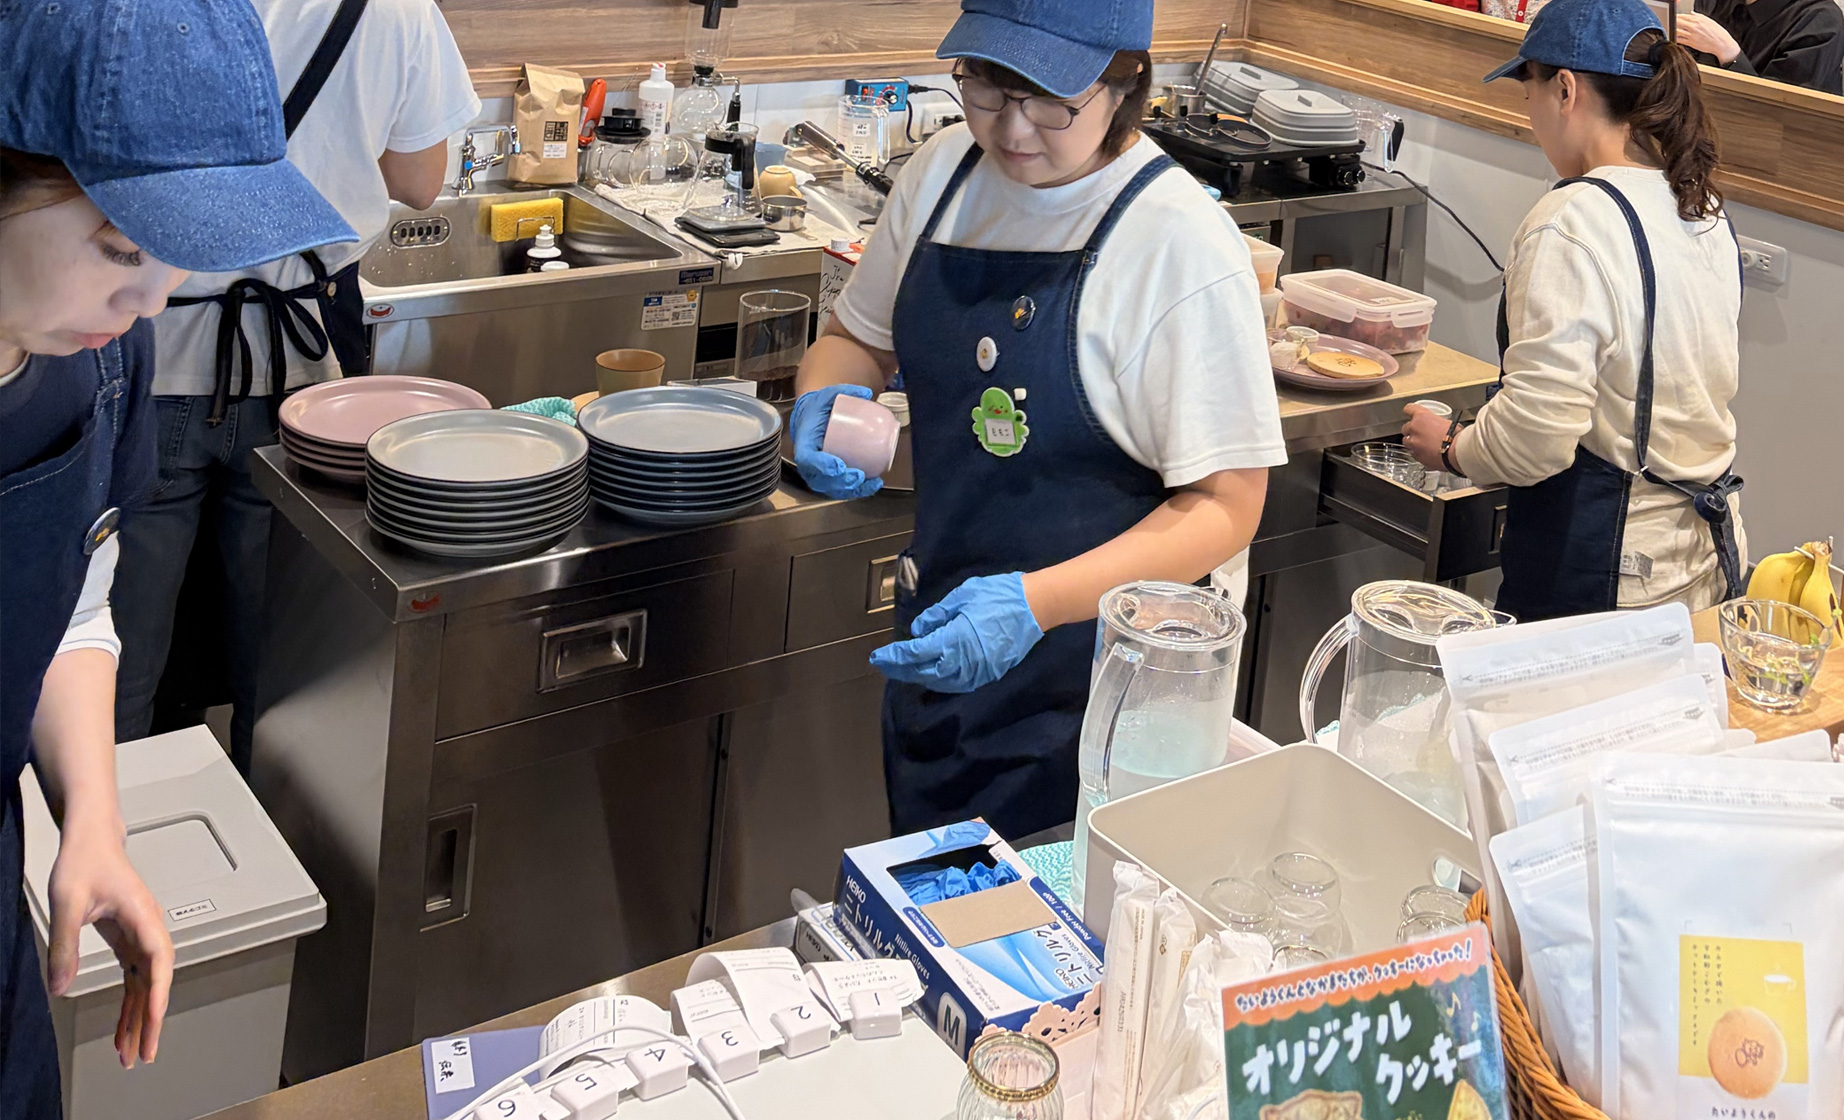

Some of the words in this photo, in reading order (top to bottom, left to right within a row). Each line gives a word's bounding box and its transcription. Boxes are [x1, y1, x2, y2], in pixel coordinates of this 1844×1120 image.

[847, 875, 866, 903] HEIKO
[1061, 908, 1074, 922] Free
[911, 953, 930, 980] Gloves
[790, 1006, 811, 1020] 2
[943, 1003, 960, 1046] M
[721, 1030, 739, 1047] 3
[1242, 1000, 1412, 1095] オリジナル
[643, 1047, 666, 1063] 4
[1375, 1032, 1482, 1105] クッキー
[575, 1073, 598, 1091] 5
[497, 1099, 516, 1118] 6
